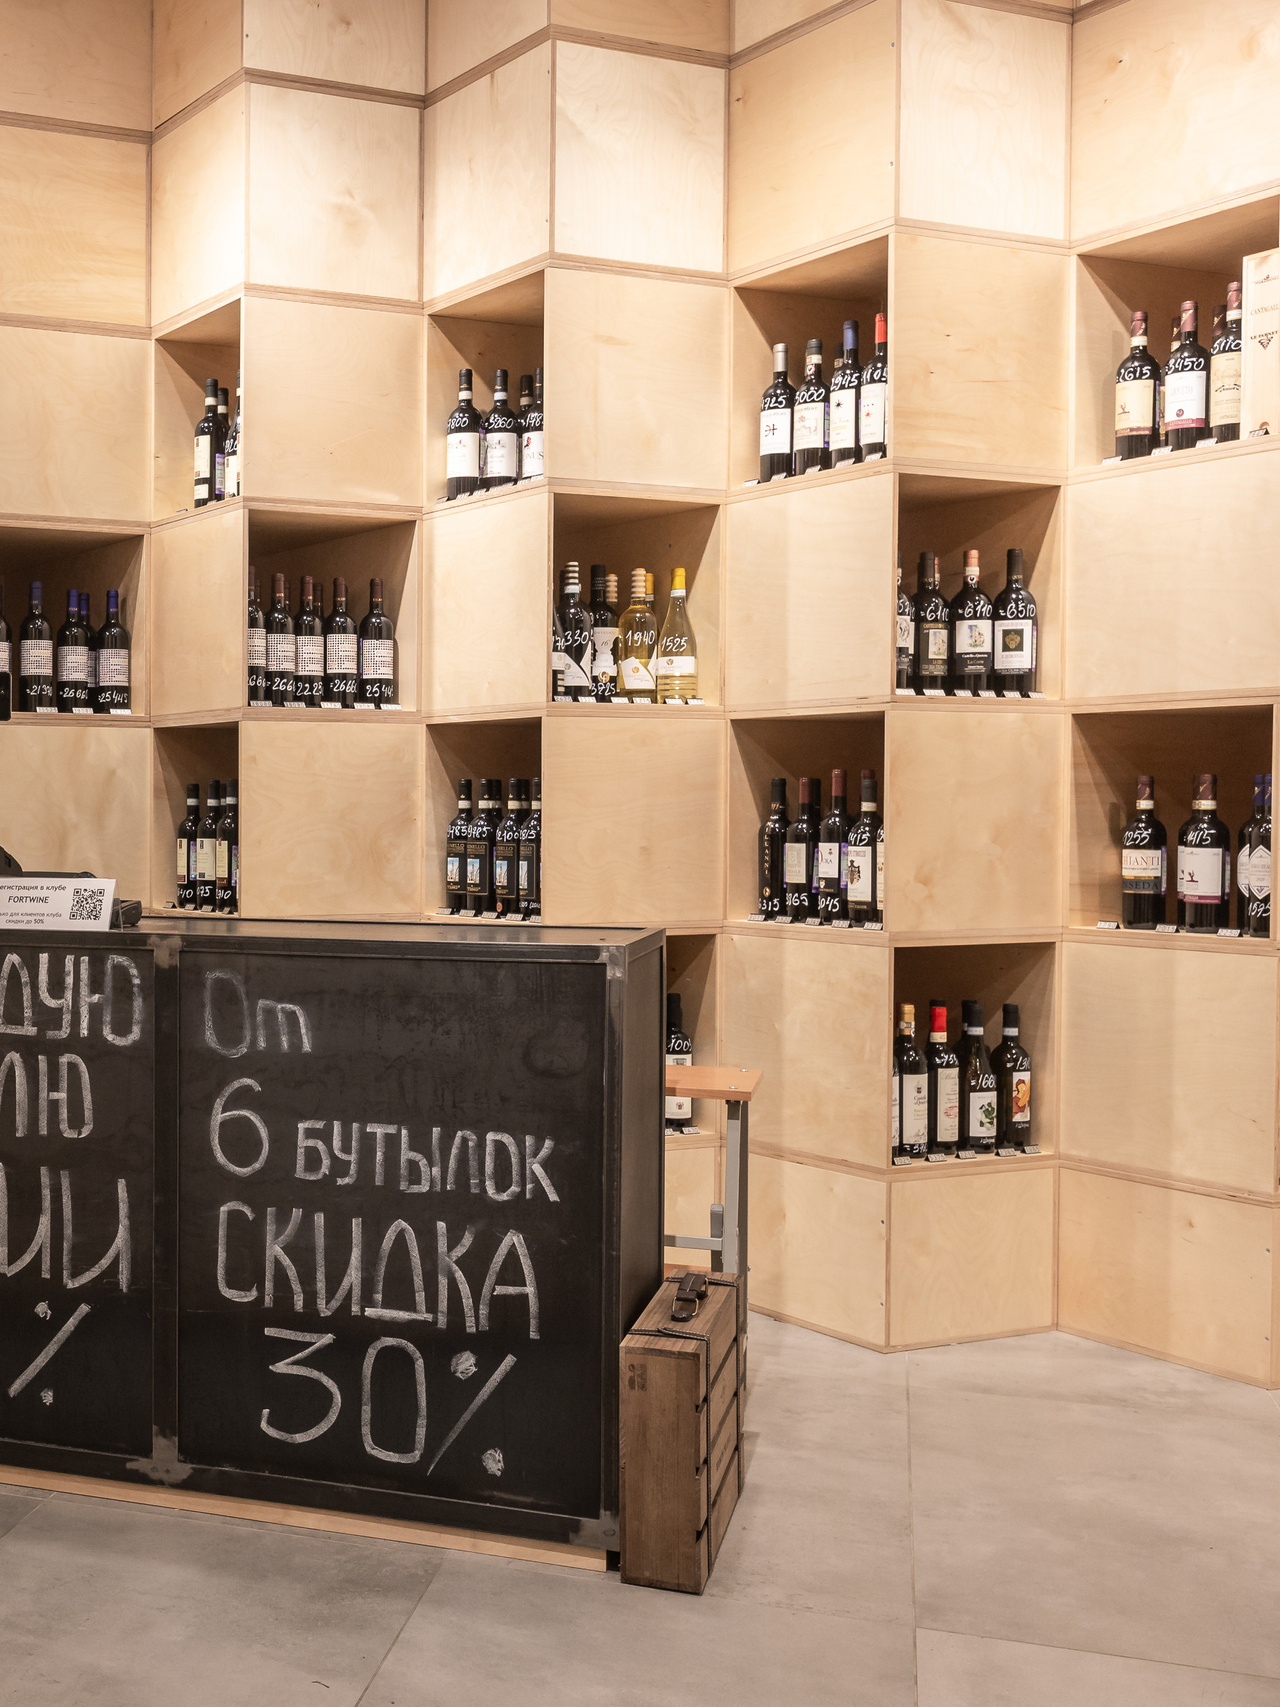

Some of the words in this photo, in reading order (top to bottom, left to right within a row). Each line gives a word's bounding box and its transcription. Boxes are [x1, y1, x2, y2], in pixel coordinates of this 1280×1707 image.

[8, 896, 50, 904] FORTWINE
[209, 1078, 269, 1178] 6
[294, 1119, 560, 1202] БУТЫЛОК
[217, 1200, 541, 1340] СКИДКА
